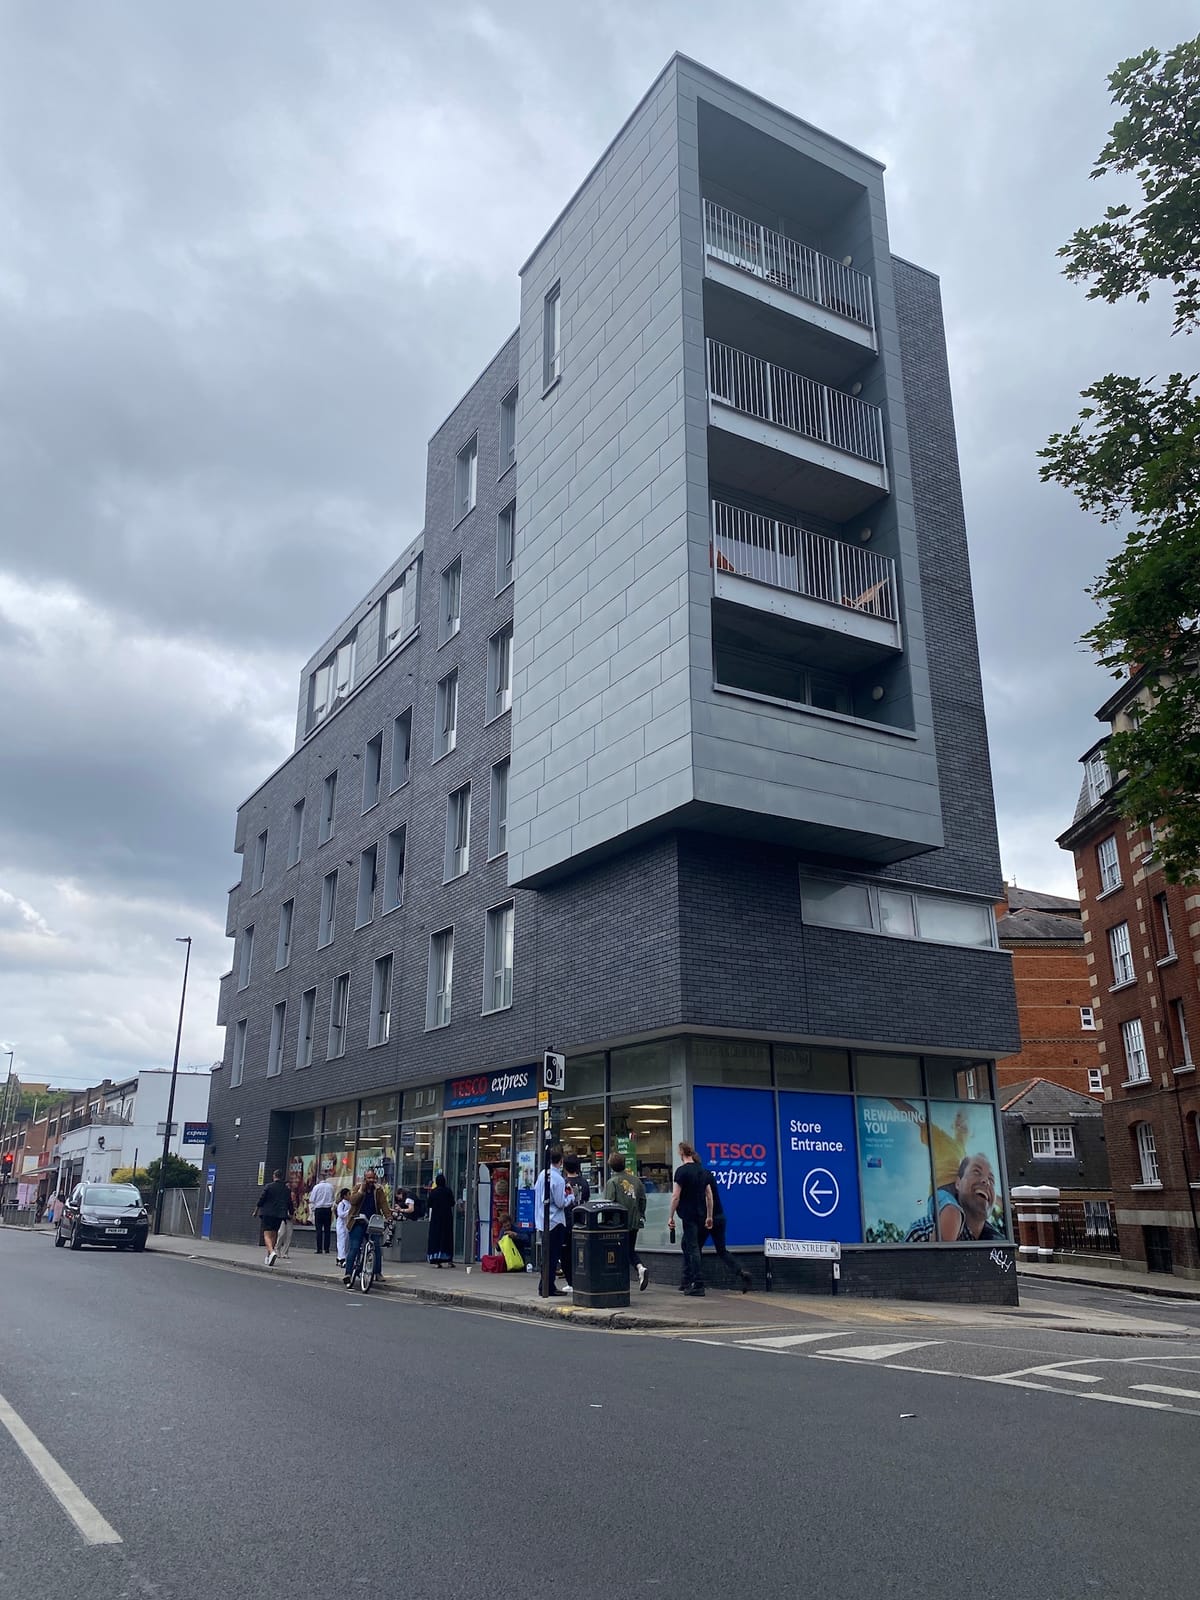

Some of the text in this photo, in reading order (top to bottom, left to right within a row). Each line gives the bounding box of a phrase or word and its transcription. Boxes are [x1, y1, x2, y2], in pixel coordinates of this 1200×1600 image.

[451, 1072, 529, 1098] TESCO express
[863, 1108, 926, 1124] REWARDING
[790, 1119, 822, 1133] Store
[864, 1121, 888, 1135] YOU
[706, 1142, 767, 1160] TESCO
[791, 1136, 843, 1152] Entrance
[767, 1241, 828, 1253] MINERVA STREET
